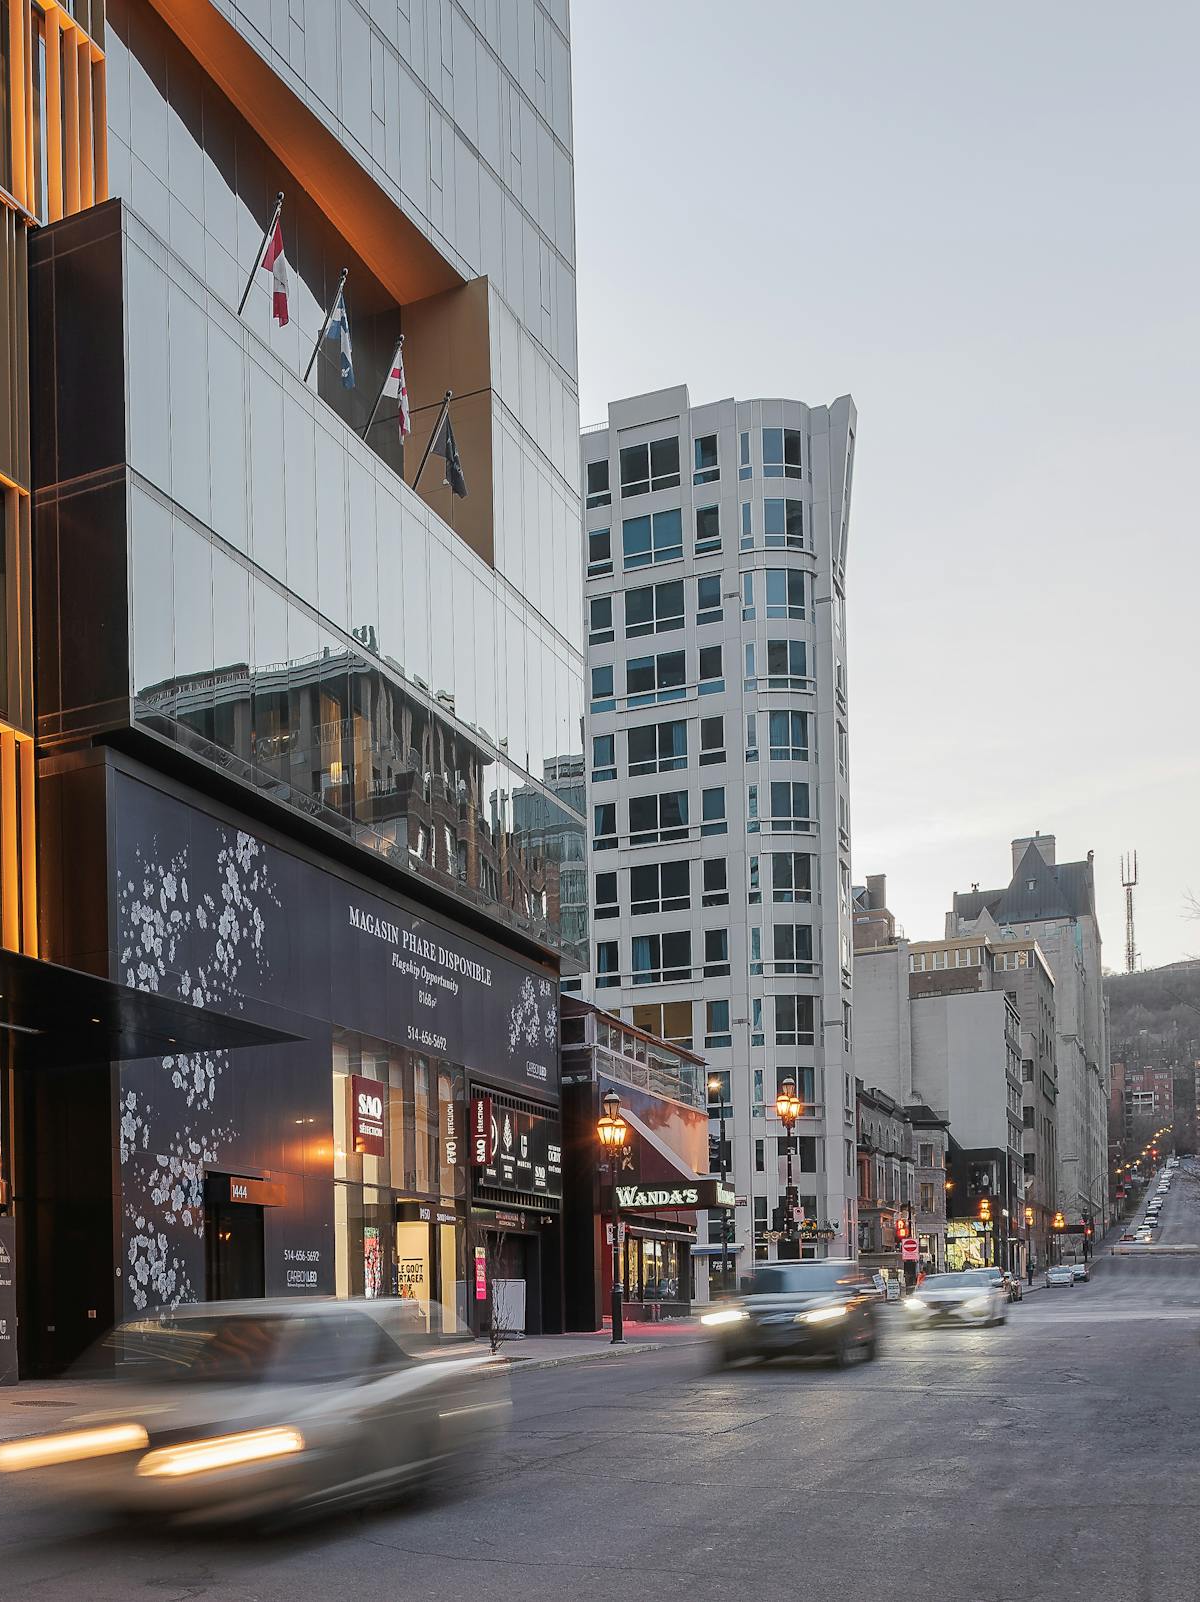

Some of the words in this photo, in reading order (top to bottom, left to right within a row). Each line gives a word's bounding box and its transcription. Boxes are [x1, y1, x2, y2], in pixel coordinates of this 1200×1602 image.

[349, 906, 400, 945] MAGASIN
[402, 930, 436, 962] PHARE
[438, 946, 492, 987] DISPONIBLE
[391, 952, 420, 980] Flagship
[421, 966, 459, 996] Opportunity
[418, 990, 432, 1007] 8168
[407, 1025, 447, 1051] 514-656-5692
[358, 1093, 382, 1120] SAQ
[476, 1139, 487, 1163] SAQ
[232, 1184, 247, 1199] 1444
[618, 1186, 699, 1207] WANDA'S
[284, 1249, 320, 1262] 514-656-5692
